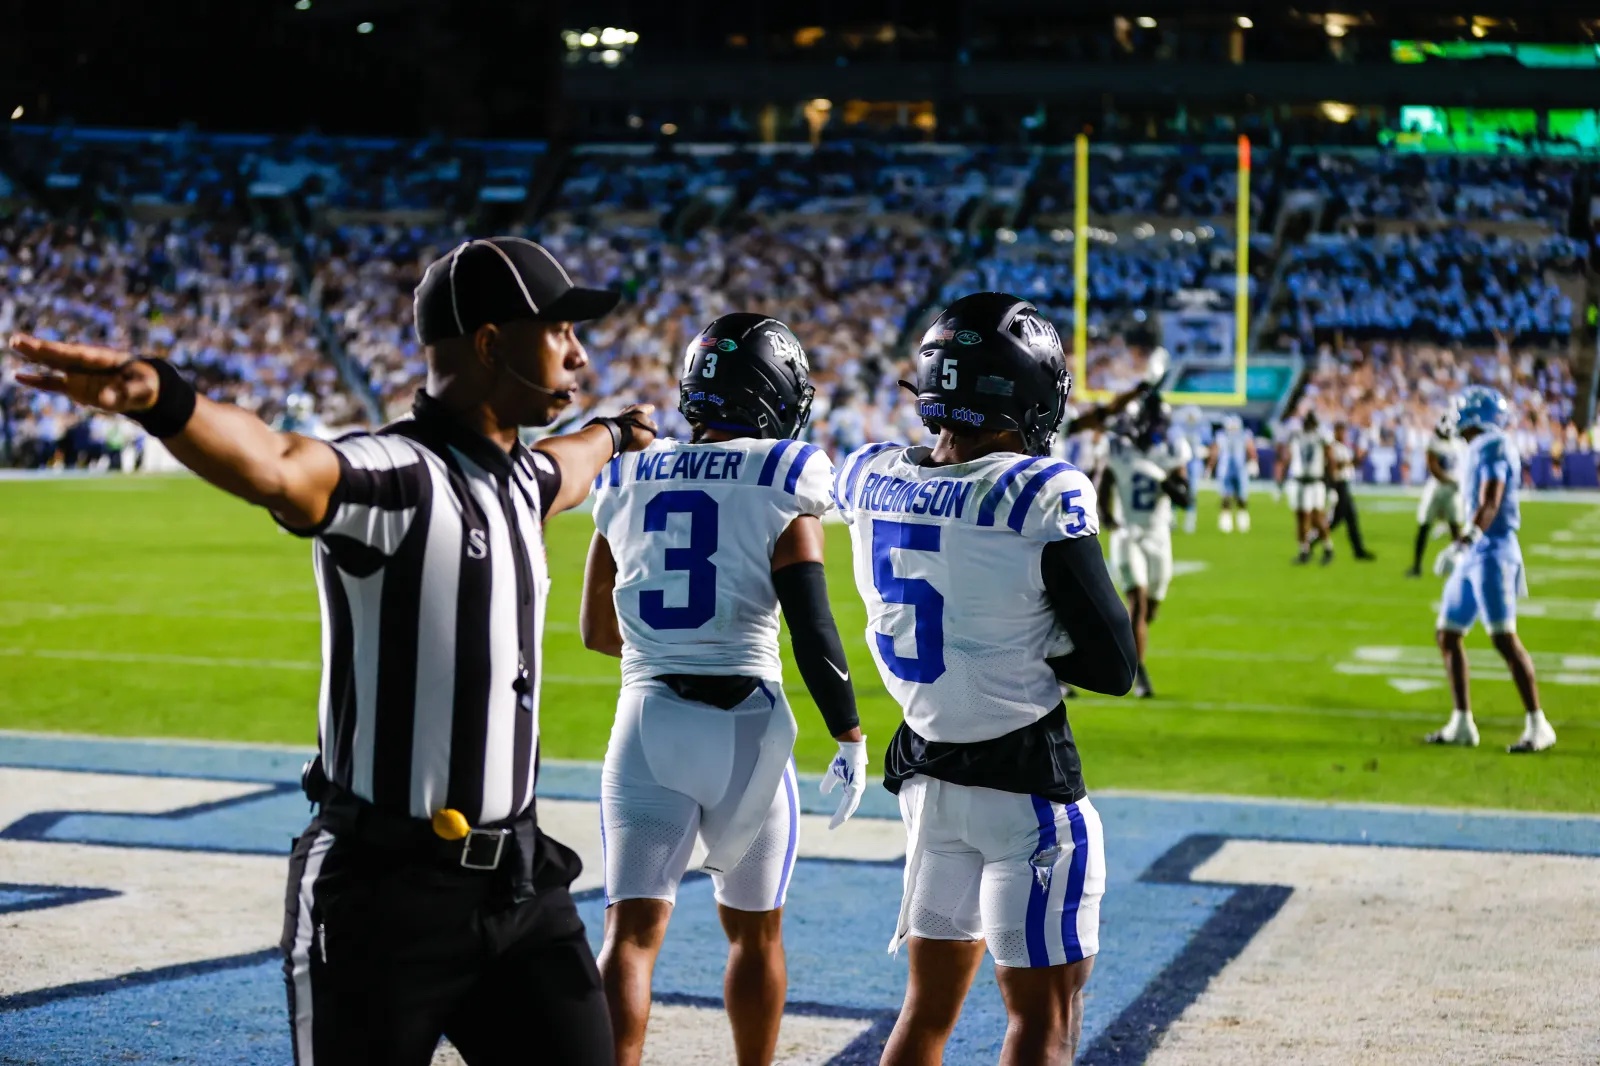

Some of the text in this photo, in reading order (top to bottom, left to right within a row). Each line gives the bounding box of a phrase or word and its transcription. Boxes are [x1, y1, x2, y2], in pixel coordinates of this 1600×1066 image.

[702, 352, 718, 379] 3
[941, 358, 958, 391] 5
[920, 401, 985, 427] bull city
[635, 451, 743, 481] WEAVER
[858, 472, 973, 519] ROBINSON
[1060, 489, 1087, 535] 5
[466, 527, 488, 560] S
[638, 489, 719, 631] 3
[871, 518, 947, 685] 5
